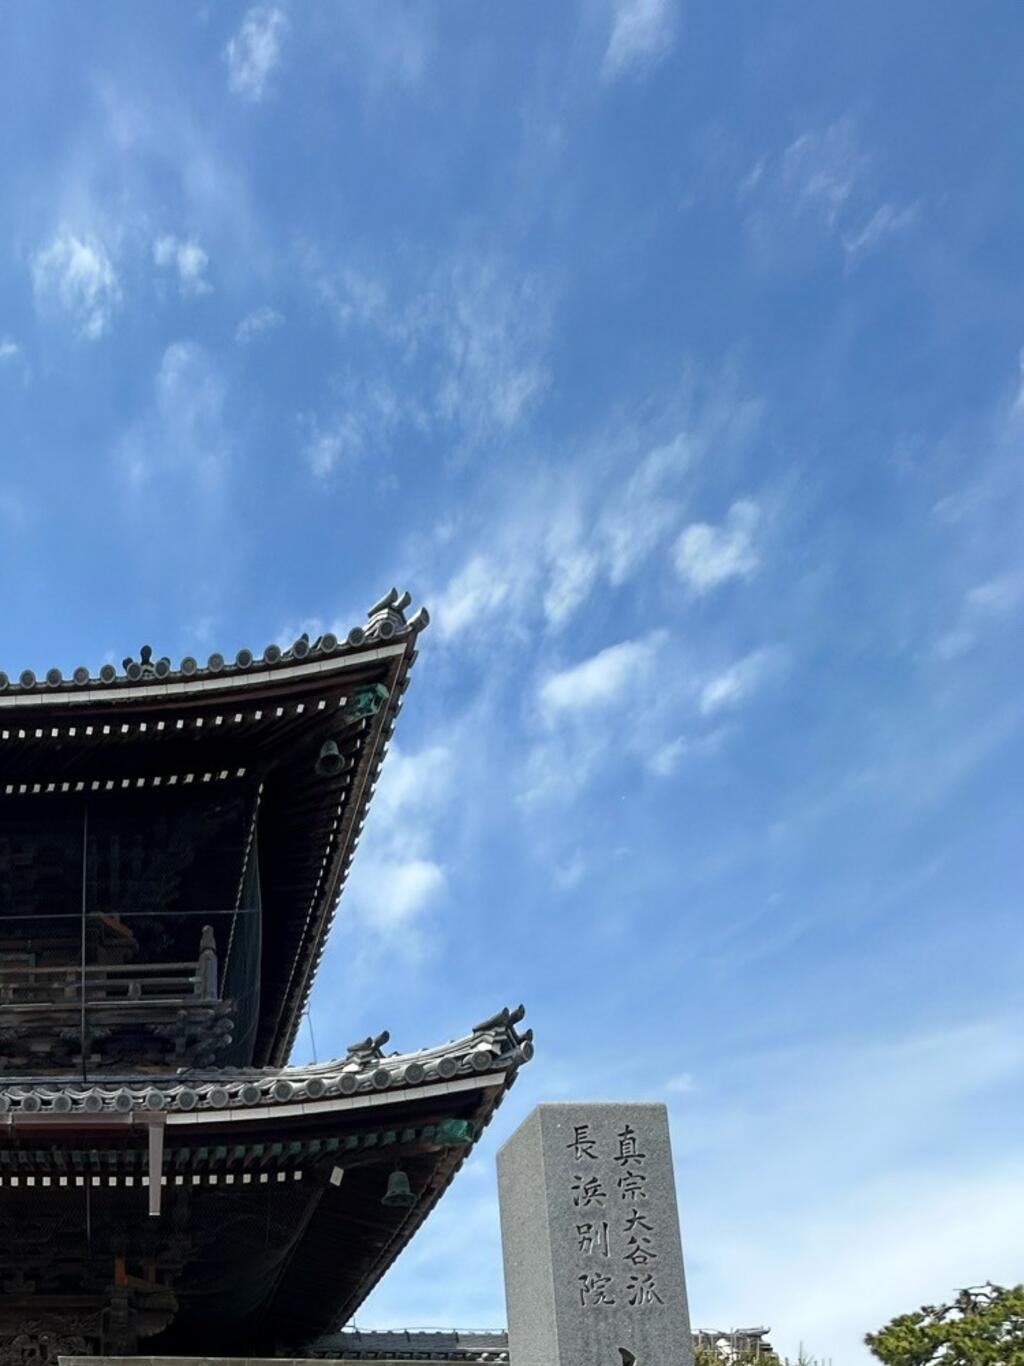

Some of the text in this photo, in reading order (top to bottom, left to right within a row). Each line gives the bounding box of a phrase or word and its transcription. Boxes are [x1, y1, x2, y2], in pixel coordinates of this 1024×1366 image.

[566, 1124, 616, 1308] 長浜別院
[612, 1124, 665, 1308] 真宗大谷派
